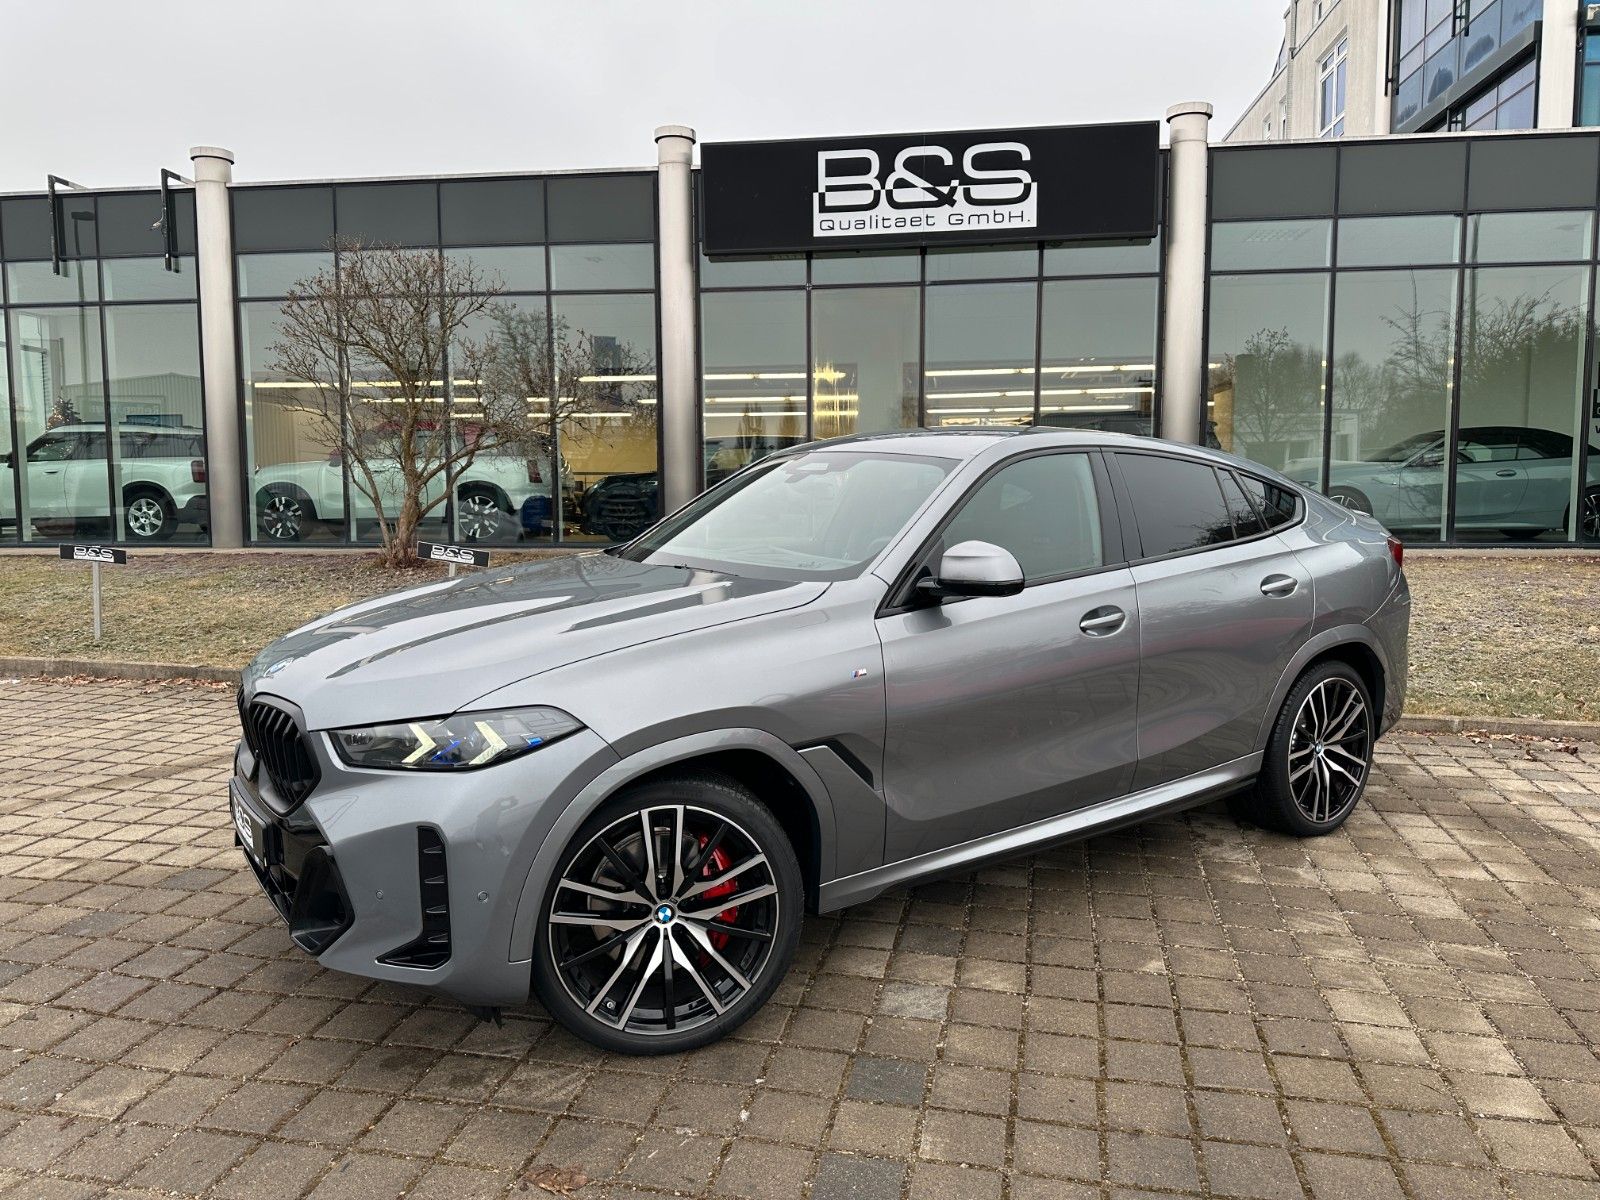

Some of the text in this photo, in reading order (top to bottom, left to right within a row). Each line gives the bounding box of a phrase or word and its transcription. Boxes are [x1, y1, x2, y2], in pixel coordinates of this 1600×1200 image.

[817, 142, 1032, 213] B&S
[819, 213, 935, 231] Qualitaet
[74, 546, 113, 559] B&S
[432, 545, 474, 560] B&S
